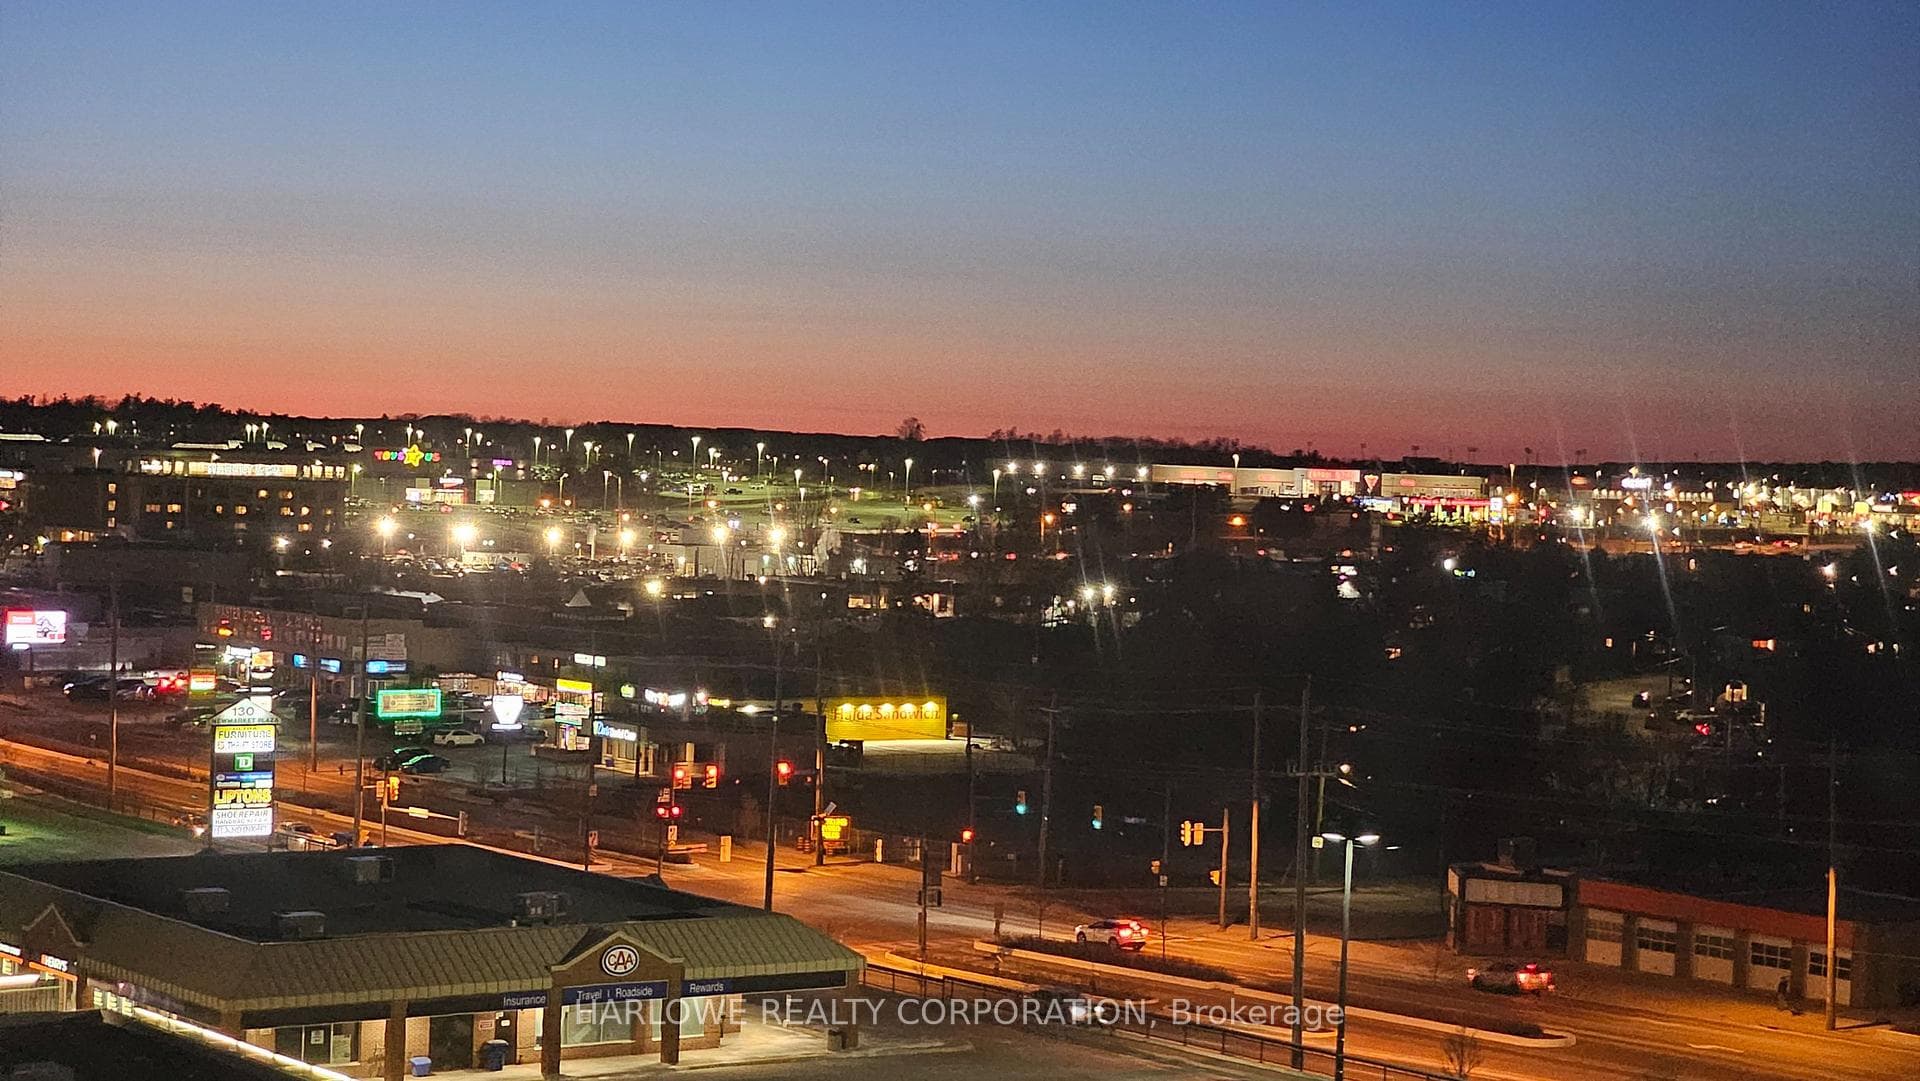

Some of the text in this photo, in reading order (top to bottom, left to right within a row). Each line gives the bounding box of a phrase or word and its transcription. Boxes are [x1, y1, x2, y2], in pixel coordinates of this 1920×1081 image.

[232, 706, 255, 716] 130
[218, 730, 271, 739] FURNITURE
[214, 788, 272, 804] LIPTONS
[607, 950, 634, 971] CAA
[577, 986, 653, 1001] Travel Roadside
[689, 982, 724, 993] Rewards
[503, 994, 547, 1007] Insurance
